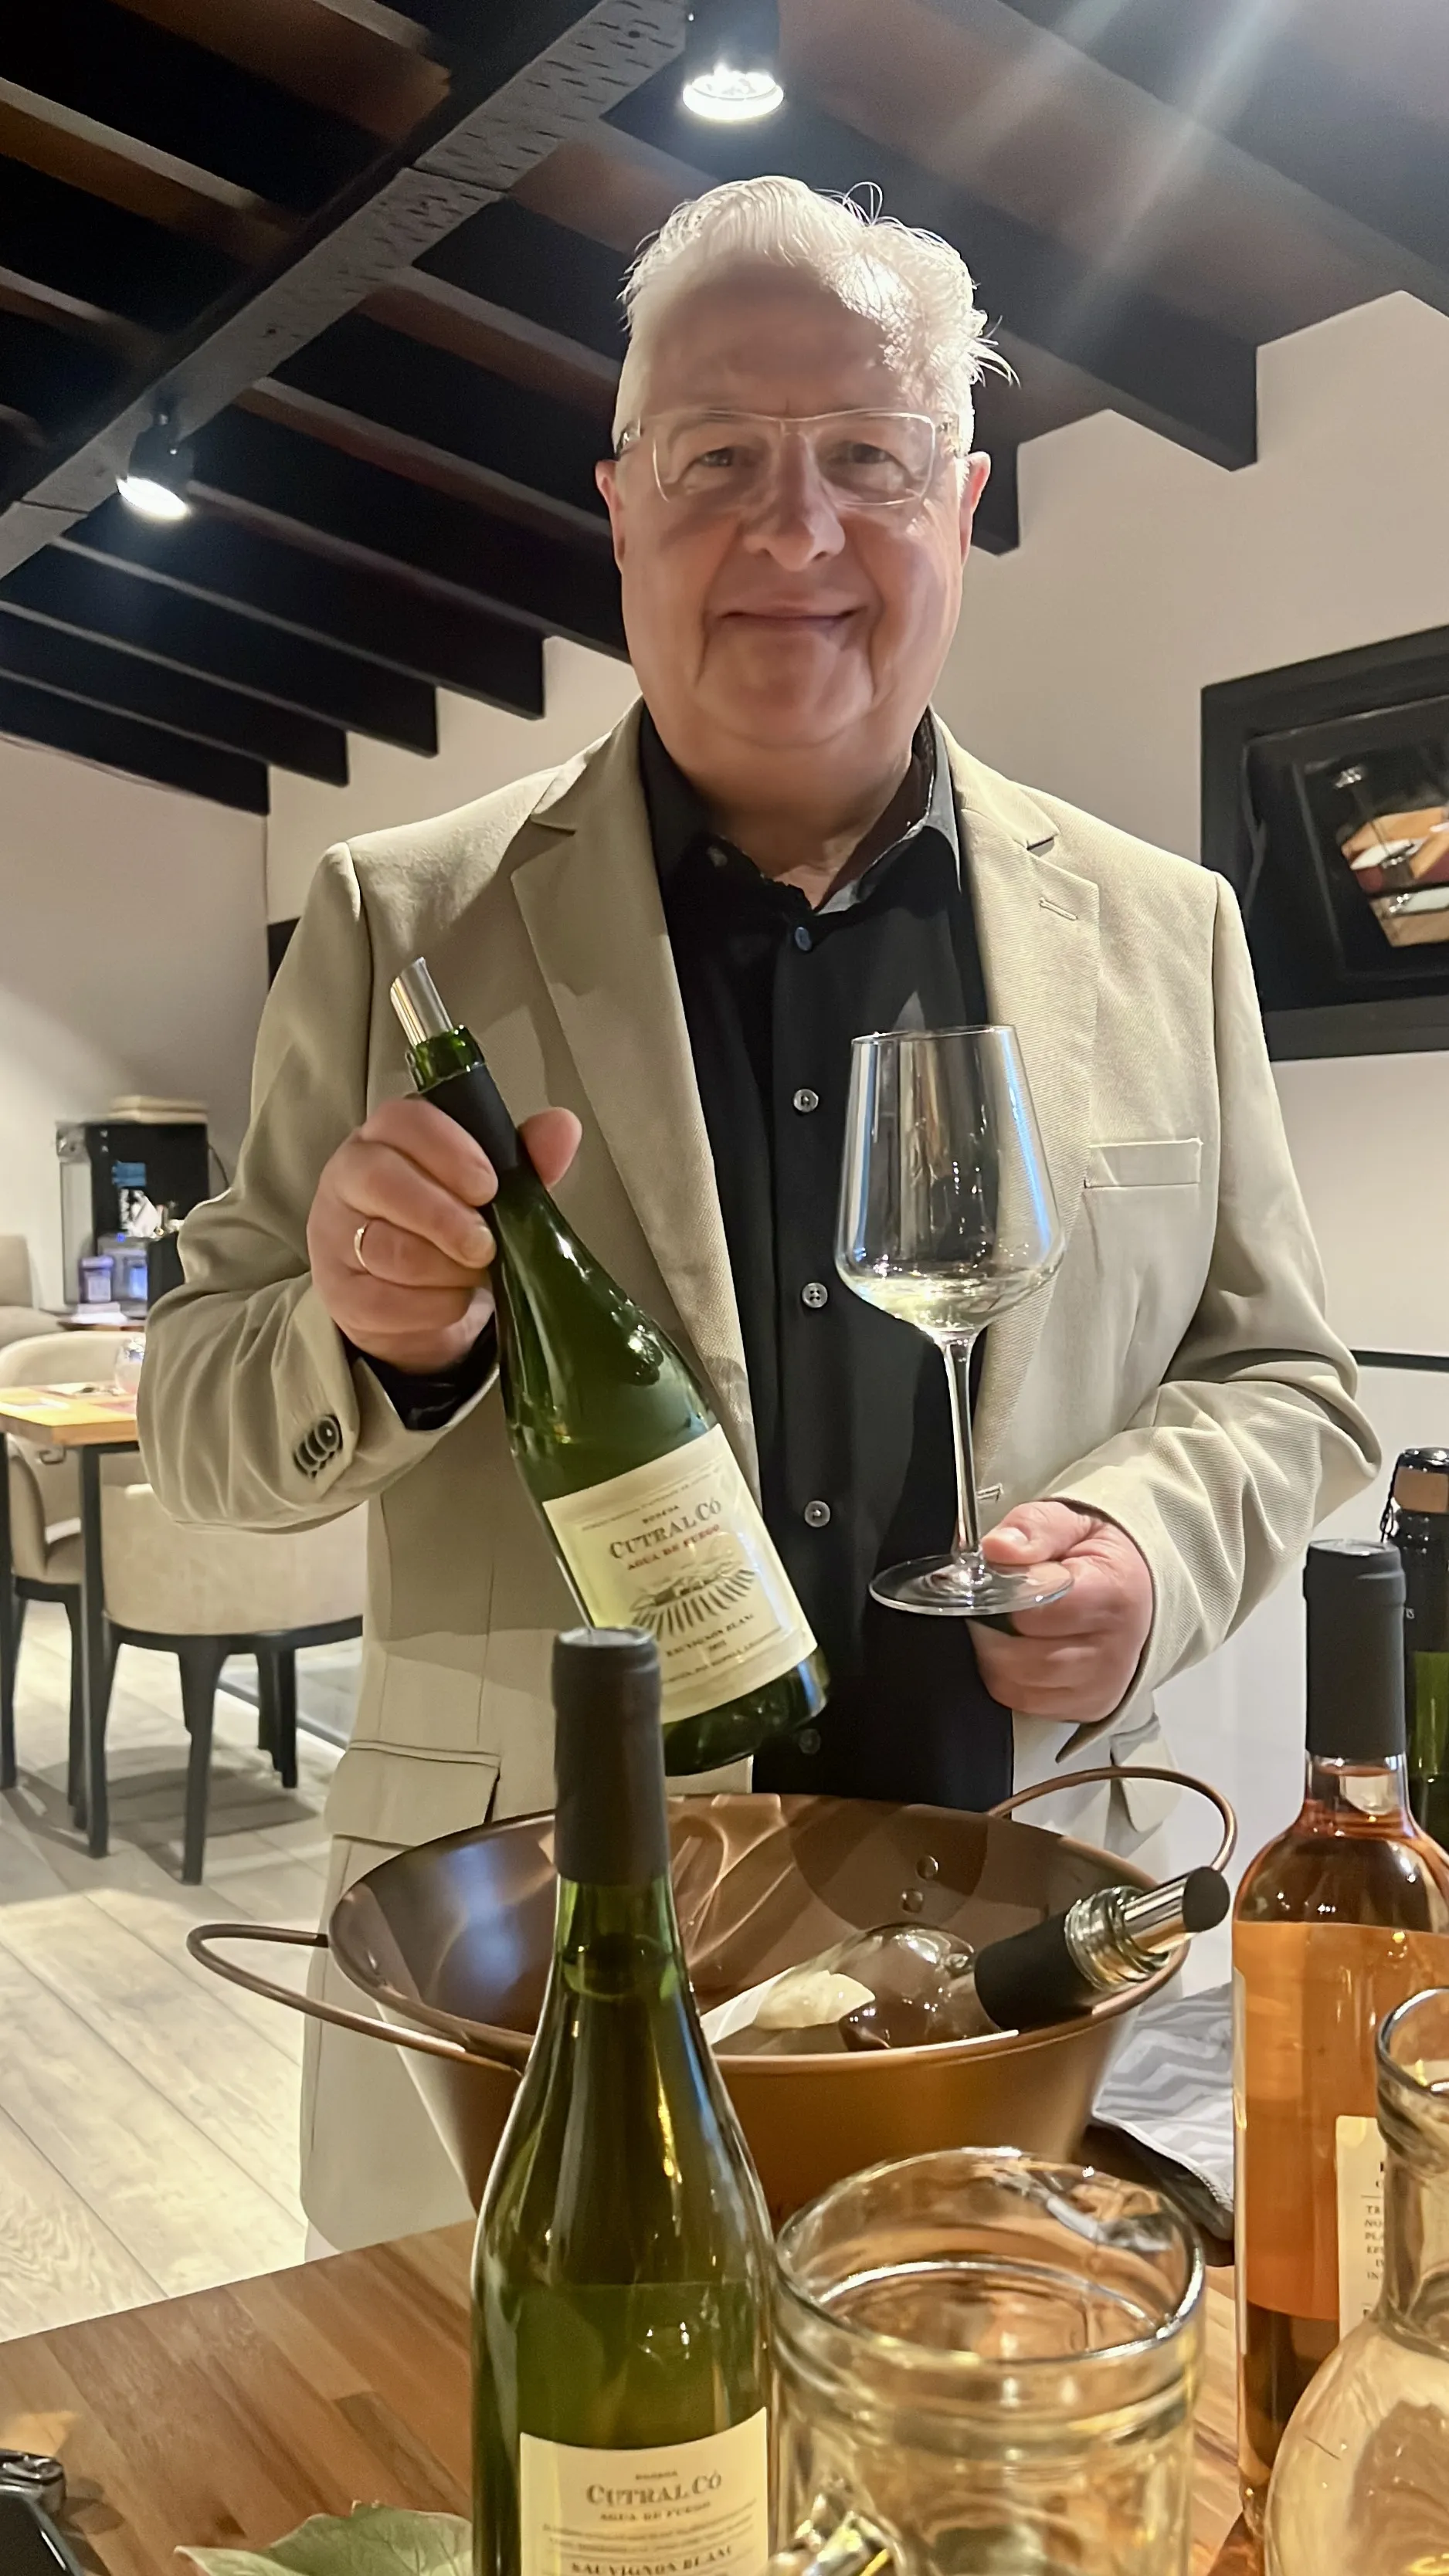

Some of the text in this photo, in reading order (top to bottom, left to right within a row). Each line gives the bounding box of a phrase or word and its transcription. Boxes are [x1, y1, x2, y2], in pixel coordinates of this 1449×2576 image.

[609, 1518, 697, 1560] CUTRAL
[663, 1544, 680, 1557] DE
[585, 2483, 690, 2507] CUTRAL
